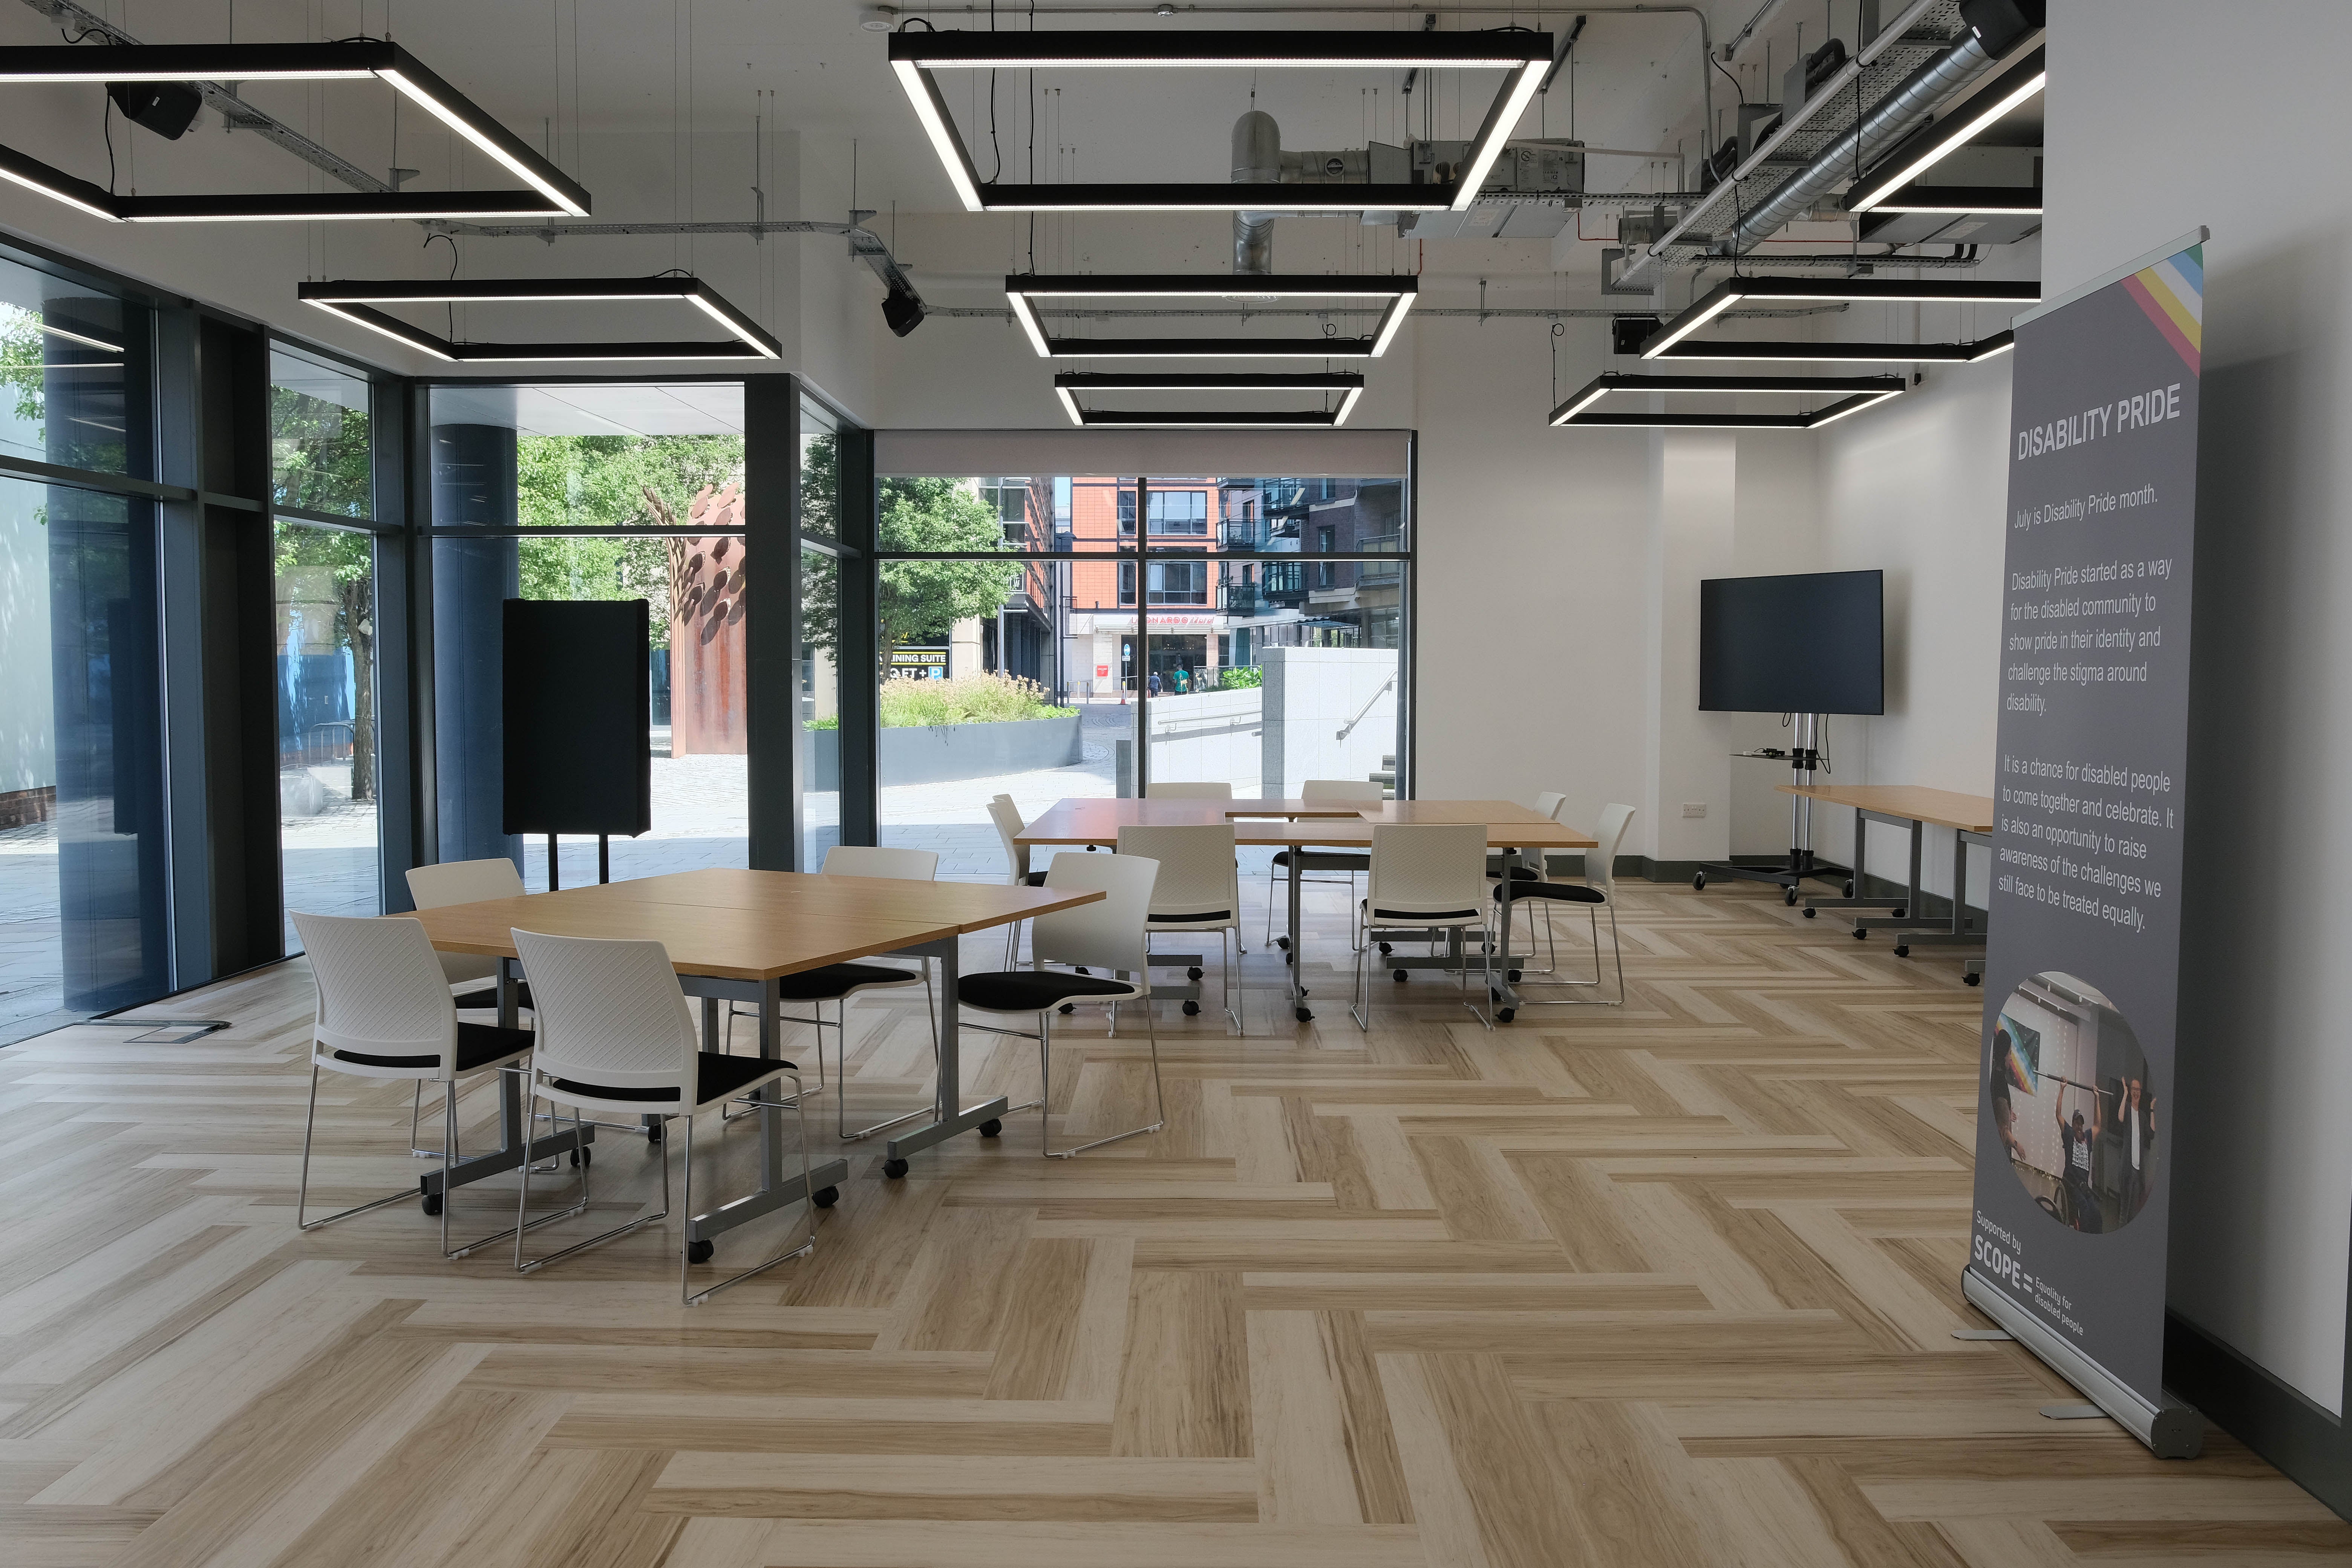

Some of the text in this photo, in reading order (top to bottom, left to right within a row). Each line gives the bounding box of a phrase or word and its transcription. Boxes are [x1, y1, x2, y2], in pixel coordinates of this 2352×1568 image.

[2018, 383, 2180, 461] DISABILITY PRIDE
[2014, 483, 2158, 531] July is Disability Pride month.
[2012, 559, 2172, 592] Disability Pride started as a way
[2011, 592, 2156, 620] for the disabled community to
[2009, 626, 2161, 654] show pride in their identity and
[902, 668, 917, 678] FT
[2008, 661, 2147, 686] challenge the stigma around
[2007, 693, 2046, 717] disability.
[2004, 754, 2170, 796] It is a chance for disabled people
[2003, 785, 2174, 829] to come together and celebrate. It
[2001, 813, 2147, 859] is also an opportunity to raise
[2000, 848, 2161, 898] awareness of the challenges we
[1998, 874, 2145, 933] still face to be treated equally.
[1977, 1210, 2021, 1255] Supported by
[2035, 1276, 2072, 1311] Equality for
[2035, 1293, 2083, 1336] disabled people
